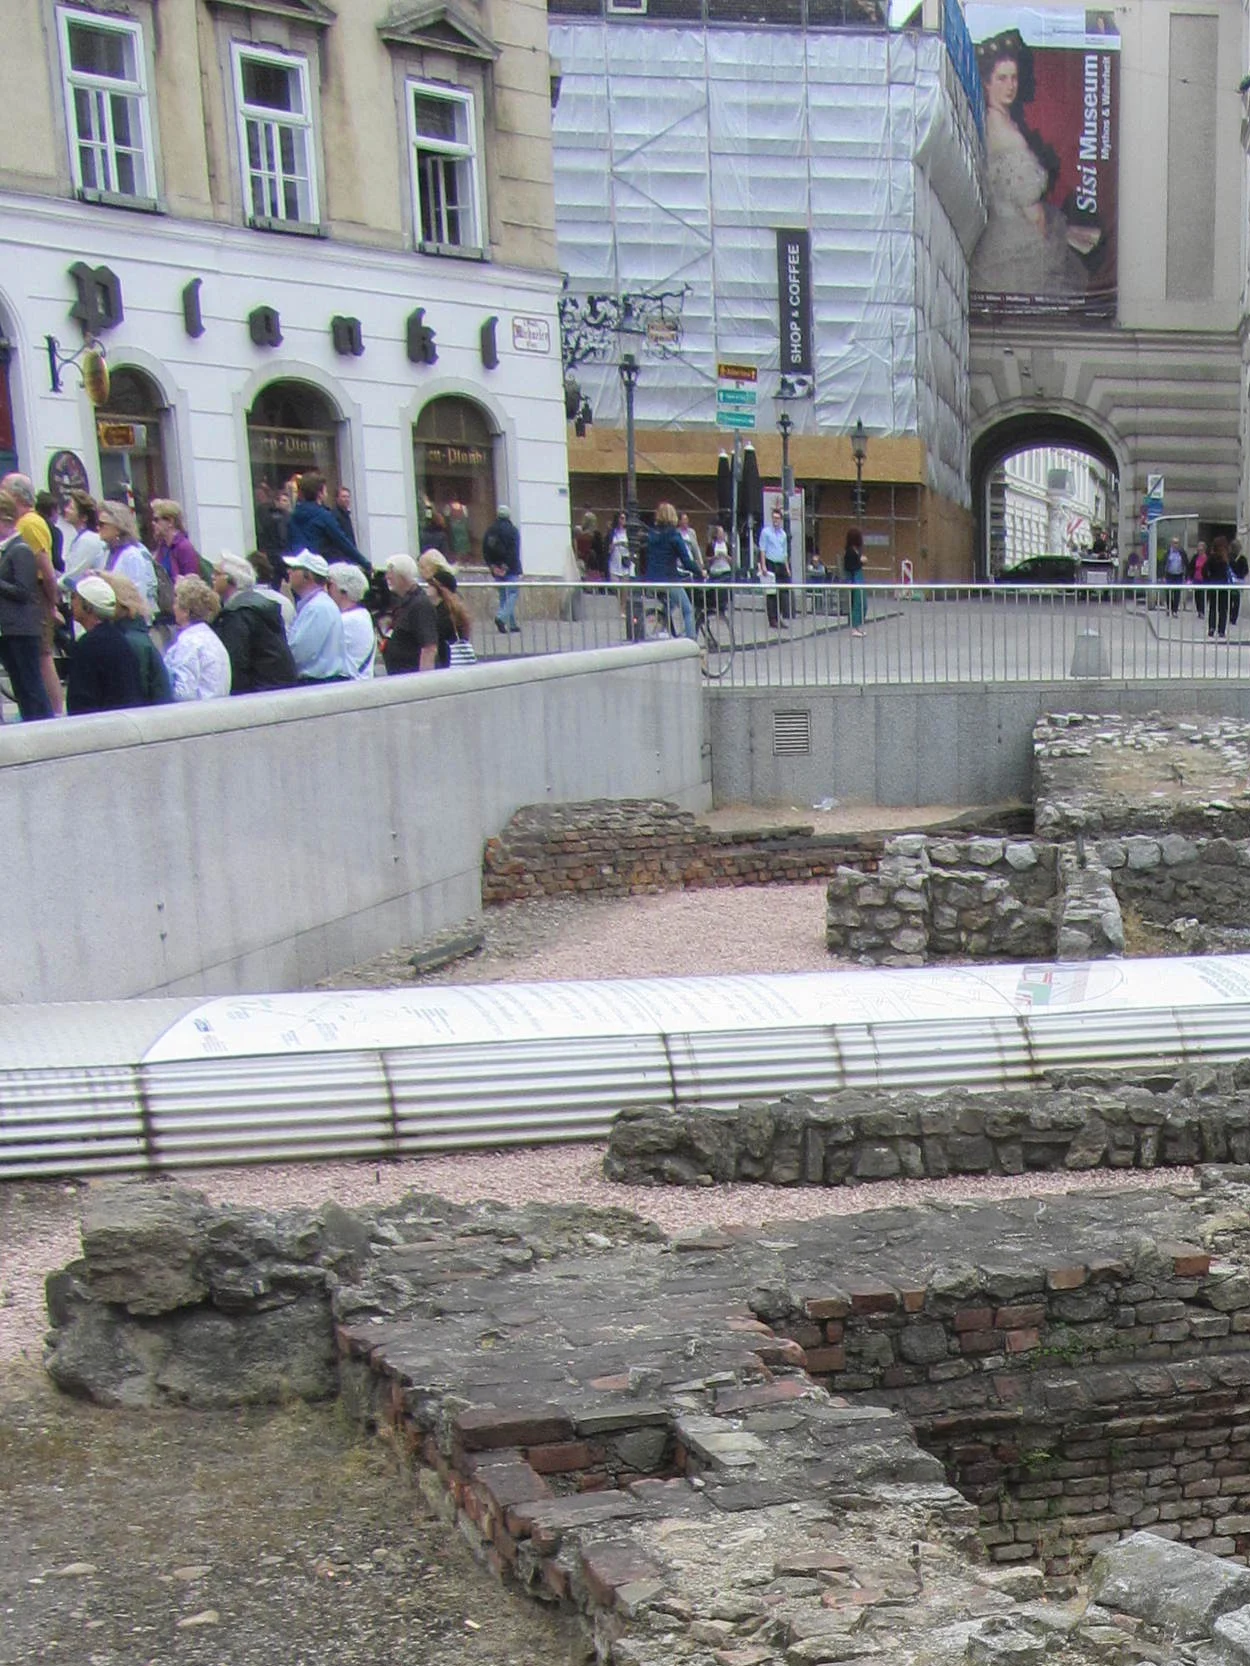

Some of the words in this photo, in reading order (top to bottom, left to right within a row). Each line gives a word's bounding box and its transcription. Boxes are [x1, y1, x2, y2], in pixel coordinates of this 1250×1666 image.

[1101, 56, 1111, 106] Wahrheit
[1079, 54, 1099, 161] Museum
[1102, 108, 1111, 117] &
[1101, 119, 1112, 161] Mythos
[1076, 165, 1098, 214] Sisi
[787, 244, 801, 306] COFFEE
[789, 321, 802, 364] SHOP
